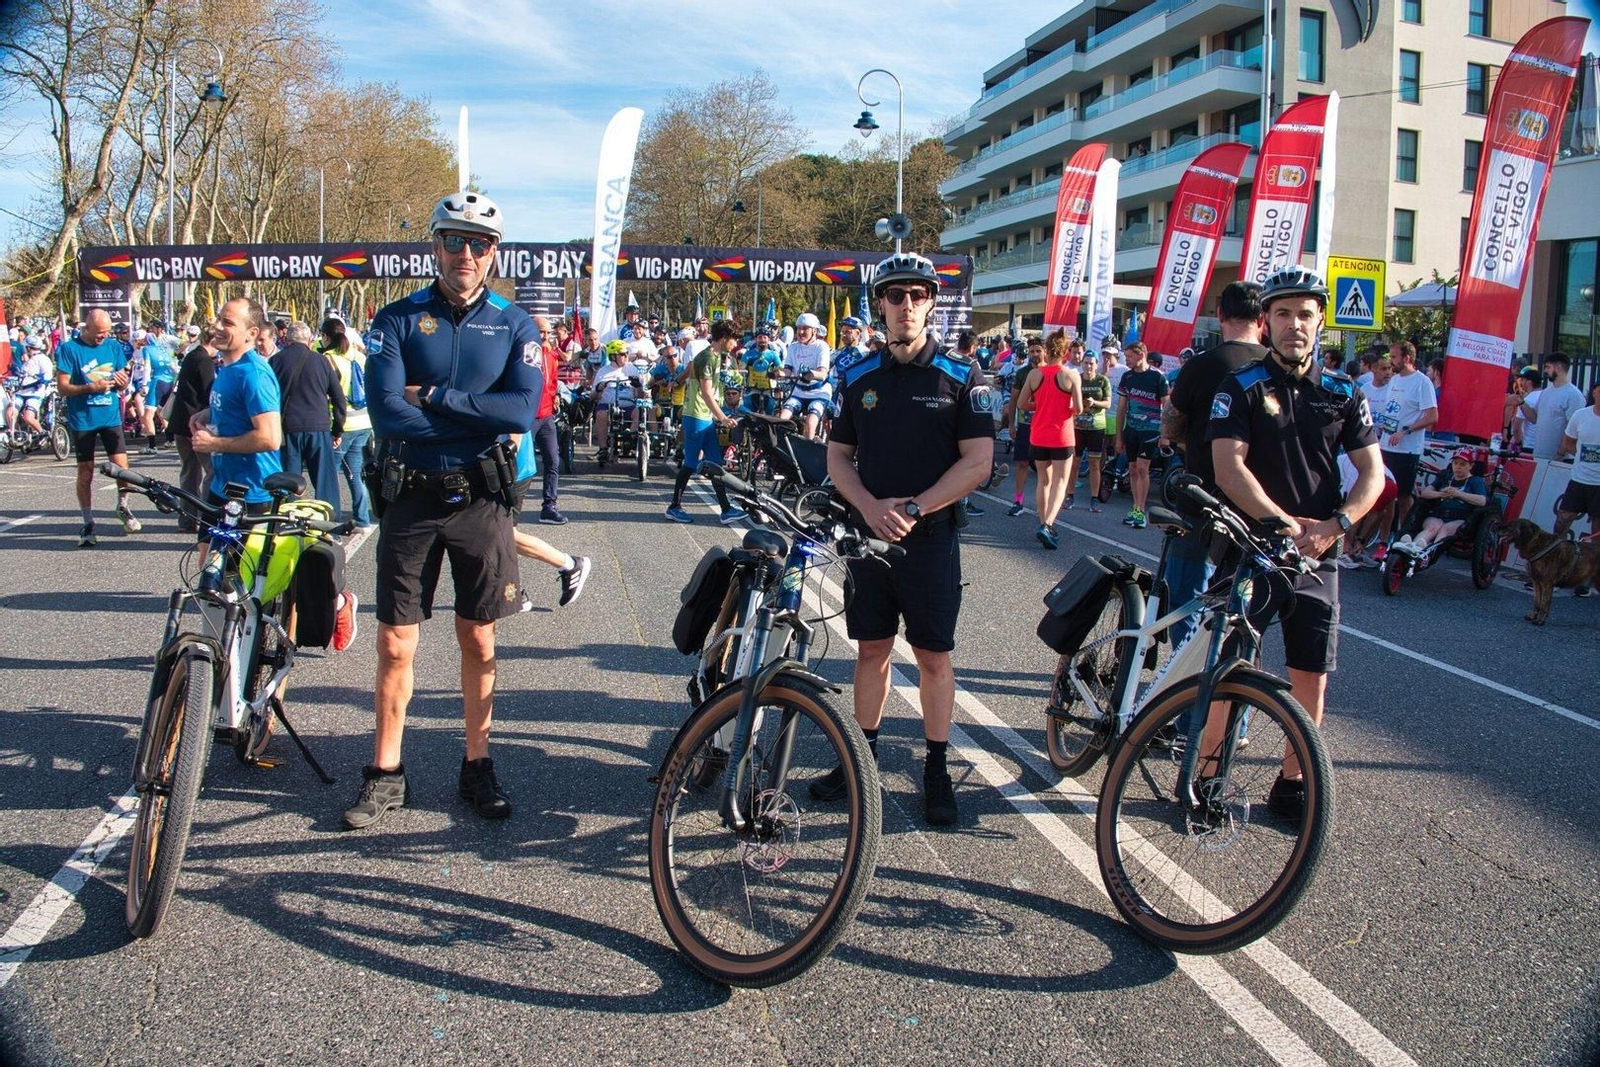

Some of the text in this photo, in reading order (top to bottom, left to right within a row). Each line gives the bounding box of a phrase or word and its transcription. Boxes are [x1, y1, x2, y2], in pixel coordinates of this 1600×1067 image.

[599, 175, 626, 294] ABANCA
[1256, 208, 1279, 283] ONCELLO
[1275, 220, 1293, 258] VIGO
[1484, 163, 1515, 272] CONCELLO
[1502, 180, 1529, 264] DE VIGO
[1060, 228, 1076, 291] CONCELLO
[1072, 236, 1085, 284] DE VIGO
[1165, 240, 1191, 313] CONCELLO
[1179, 251, 1202, 307] DE VIGO
[1333, 260, 1380, 272] ATENCIÓN
[1473, 352, 1490, 361] PARA
[656, 752, 682, 817] MAXXIS
[1107, 867, 1142, 917] MAXXIS
